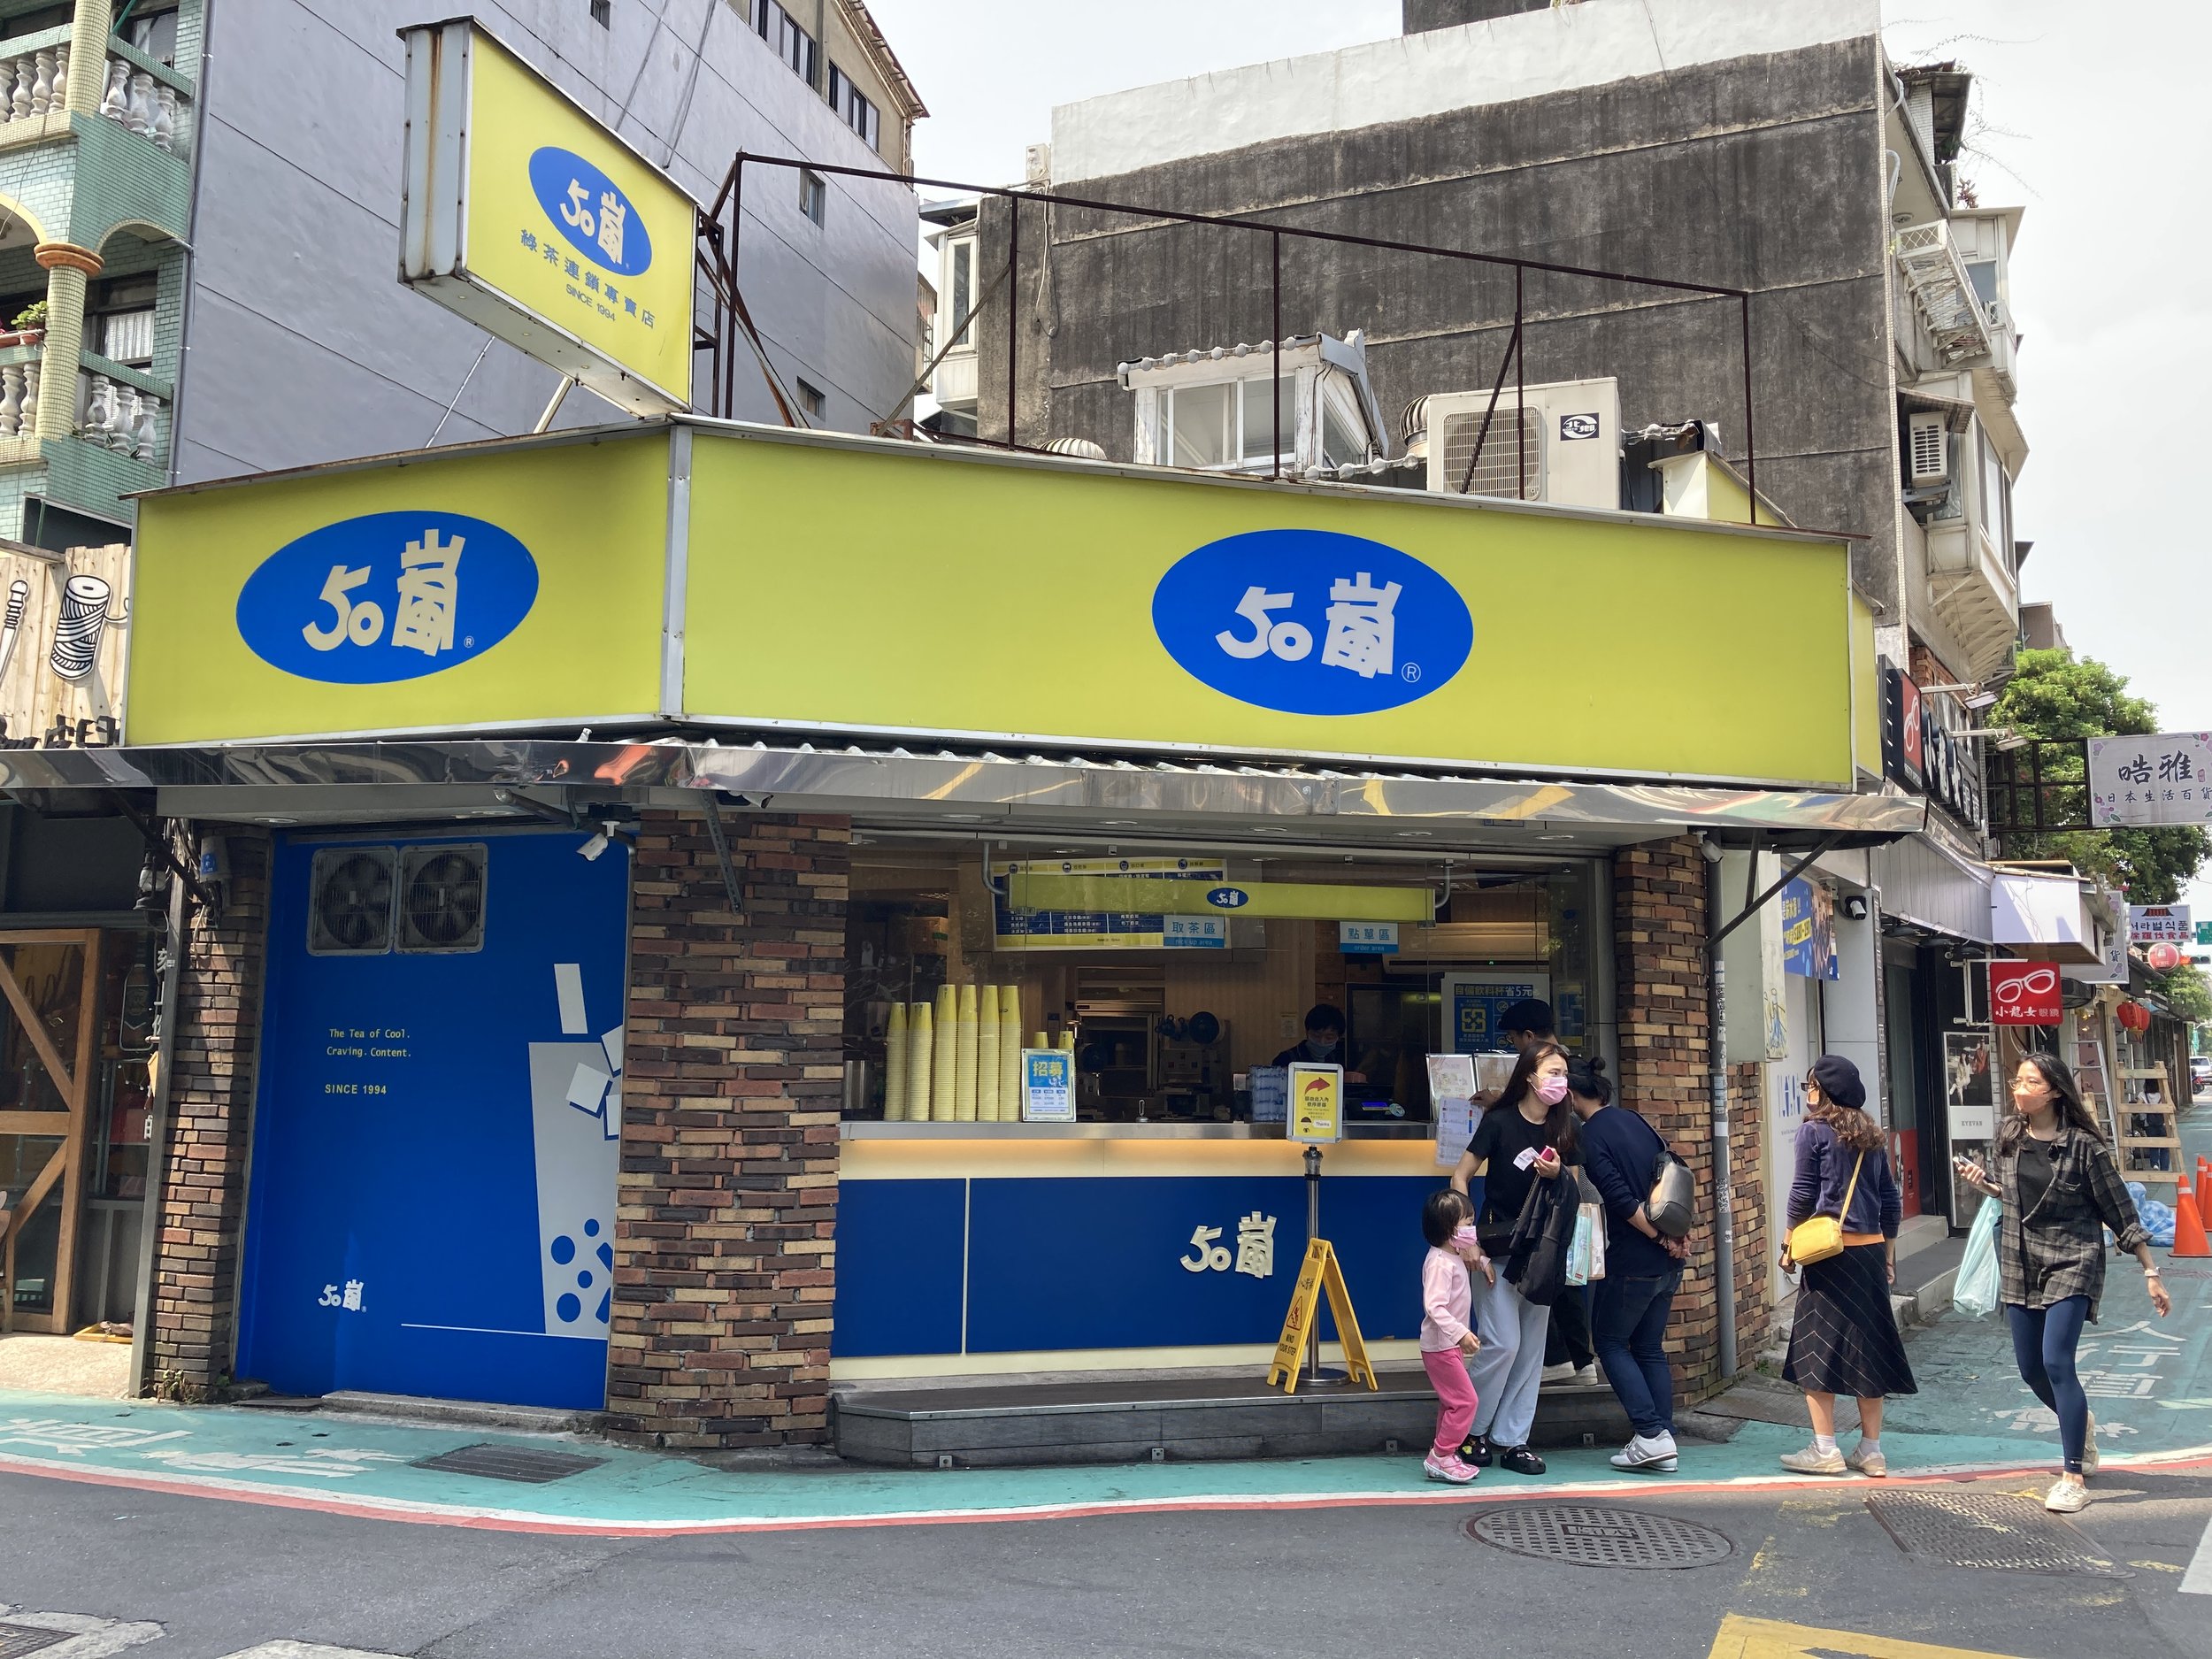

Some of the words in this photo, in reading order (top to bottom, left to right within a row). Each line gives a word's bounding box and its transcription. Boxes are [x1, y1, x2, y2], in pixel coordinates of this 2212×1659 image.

[559, 178, 626, 265] 50嵐
[520, 229, 656, 329] 綠茶連鎖專賣店
[565, 283, 593, 308] SINCE
[596, 303, 616, 322] 1994
[302, 528, 466, 657] 50嵐
[1215, 572, 1403, 680] 50嵐
[2108, 787, 2212, 803] 日本生活百貨
[1216, 890, 1239, 906] 50嵐
[1172, 921, 1216, 934] 取茶區
[1348, 927, 1390, 941] 點單區
[329, 1028, 344, 1038] The
[349, 1028, 365, 1038] Tea
[369, 1028, 380, 1038] of
[385, 1028, 410, 1038] Cool.
[326, 1046, 367, 1057] Craving.
[370, 1048, 411, 1057] Content.
[1033, 1061, 1064, 1077] 招募
[325, 1084, 358, 1094] SINCE
[363, 1085, 387, 1094] 1994
[1179, 1210, 1278, 1279] 50嵐
[318, 1279, 365, 1311] 50嵐
